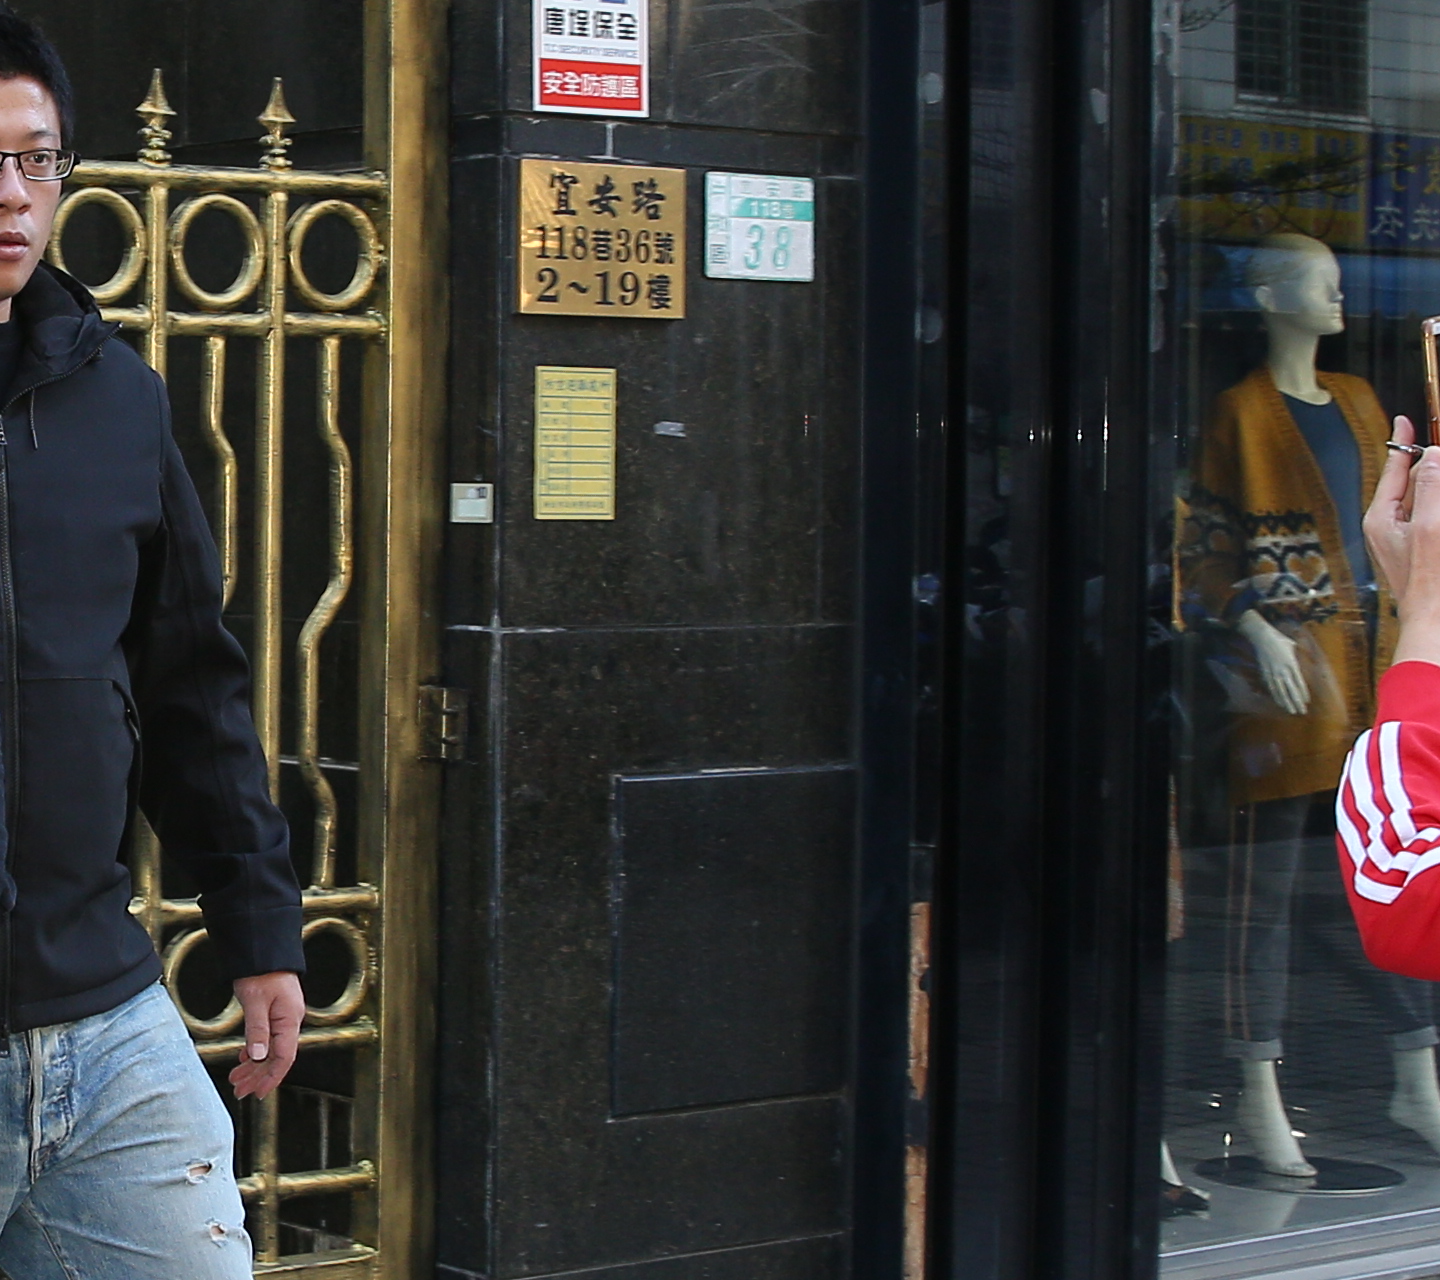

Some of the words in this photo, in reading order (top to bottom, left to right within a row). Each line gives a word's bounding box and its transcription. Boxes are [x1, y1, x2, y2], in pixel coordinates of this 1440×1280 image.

[542, 71, 640, 99] 安全防護區
[549, 172, 666, 220] 宜安路
[535, 223, 676, 265] 118巷36號
[744, 224, 793, 271] 38
